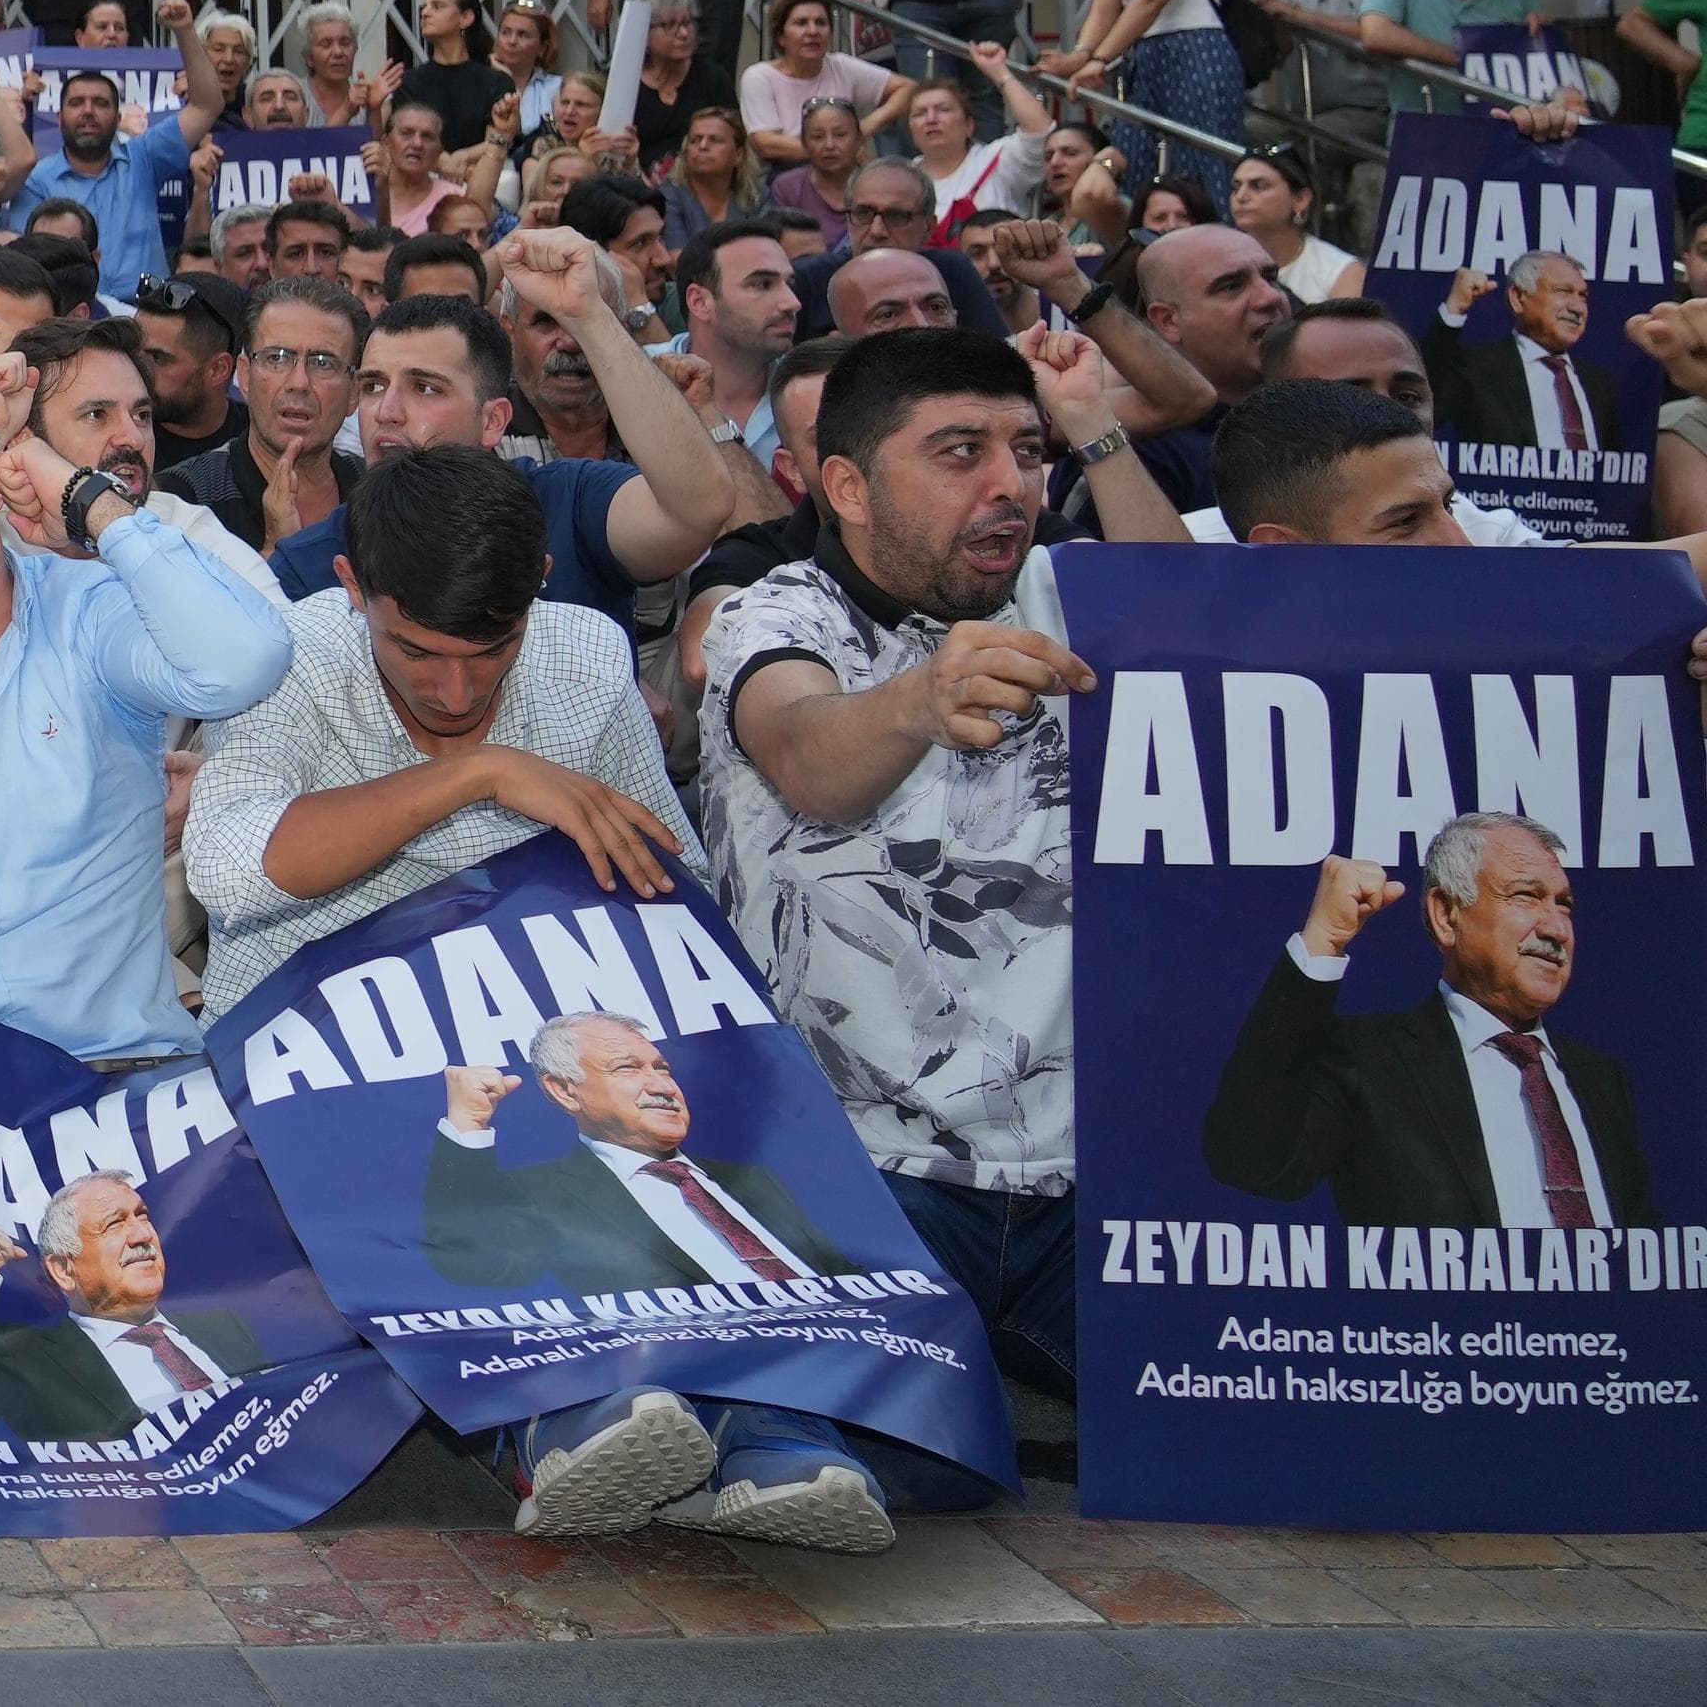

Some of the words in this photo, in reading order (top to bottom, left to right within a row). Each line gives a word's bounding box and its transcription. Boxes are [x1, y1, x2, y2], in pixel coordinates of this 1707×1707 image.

[1374, 176, 1664, 285] ADANA
[1458, 442, 1648, 484] KARALAR'DIR
[1513, 491, 1599, 514] edilemez,
[1573, 519, 1630, 539] eğmez.
[1092, 670, 1695, 869] ADANA
[243, 902, 776, 1106] ADANA
[1102, 1219, 1327, 1289] ZEYDAN
[461, 1348, 583, 1378] Adanalı
[755, 1324, 858, 1341] boyun
[862, 1326, 967, 1371] eğmez.
[1217, 1316, 1335, 1357] Adana
[1341, 1318, 1452, 1357] tutsak
[1458, 1319, 1628, 1365] edilemez,
[1136, 1362, 1277, 1401] Adanalı
[1285, 1366, 1463, 1417] haksızlığa
[1469, 1368, 1578, 1414] boyun
[1584, 1374, 1699, 1417] eğmez.
[1, 1483, 158, 1501] haksızlığa
[163, 1452, 256, 1497] boyun
[255, 1371, 339, 1456] eğmez.
[41, 1469, 138, 1485] tutsak
[143, 1397, 272, 1481] edilemez,
